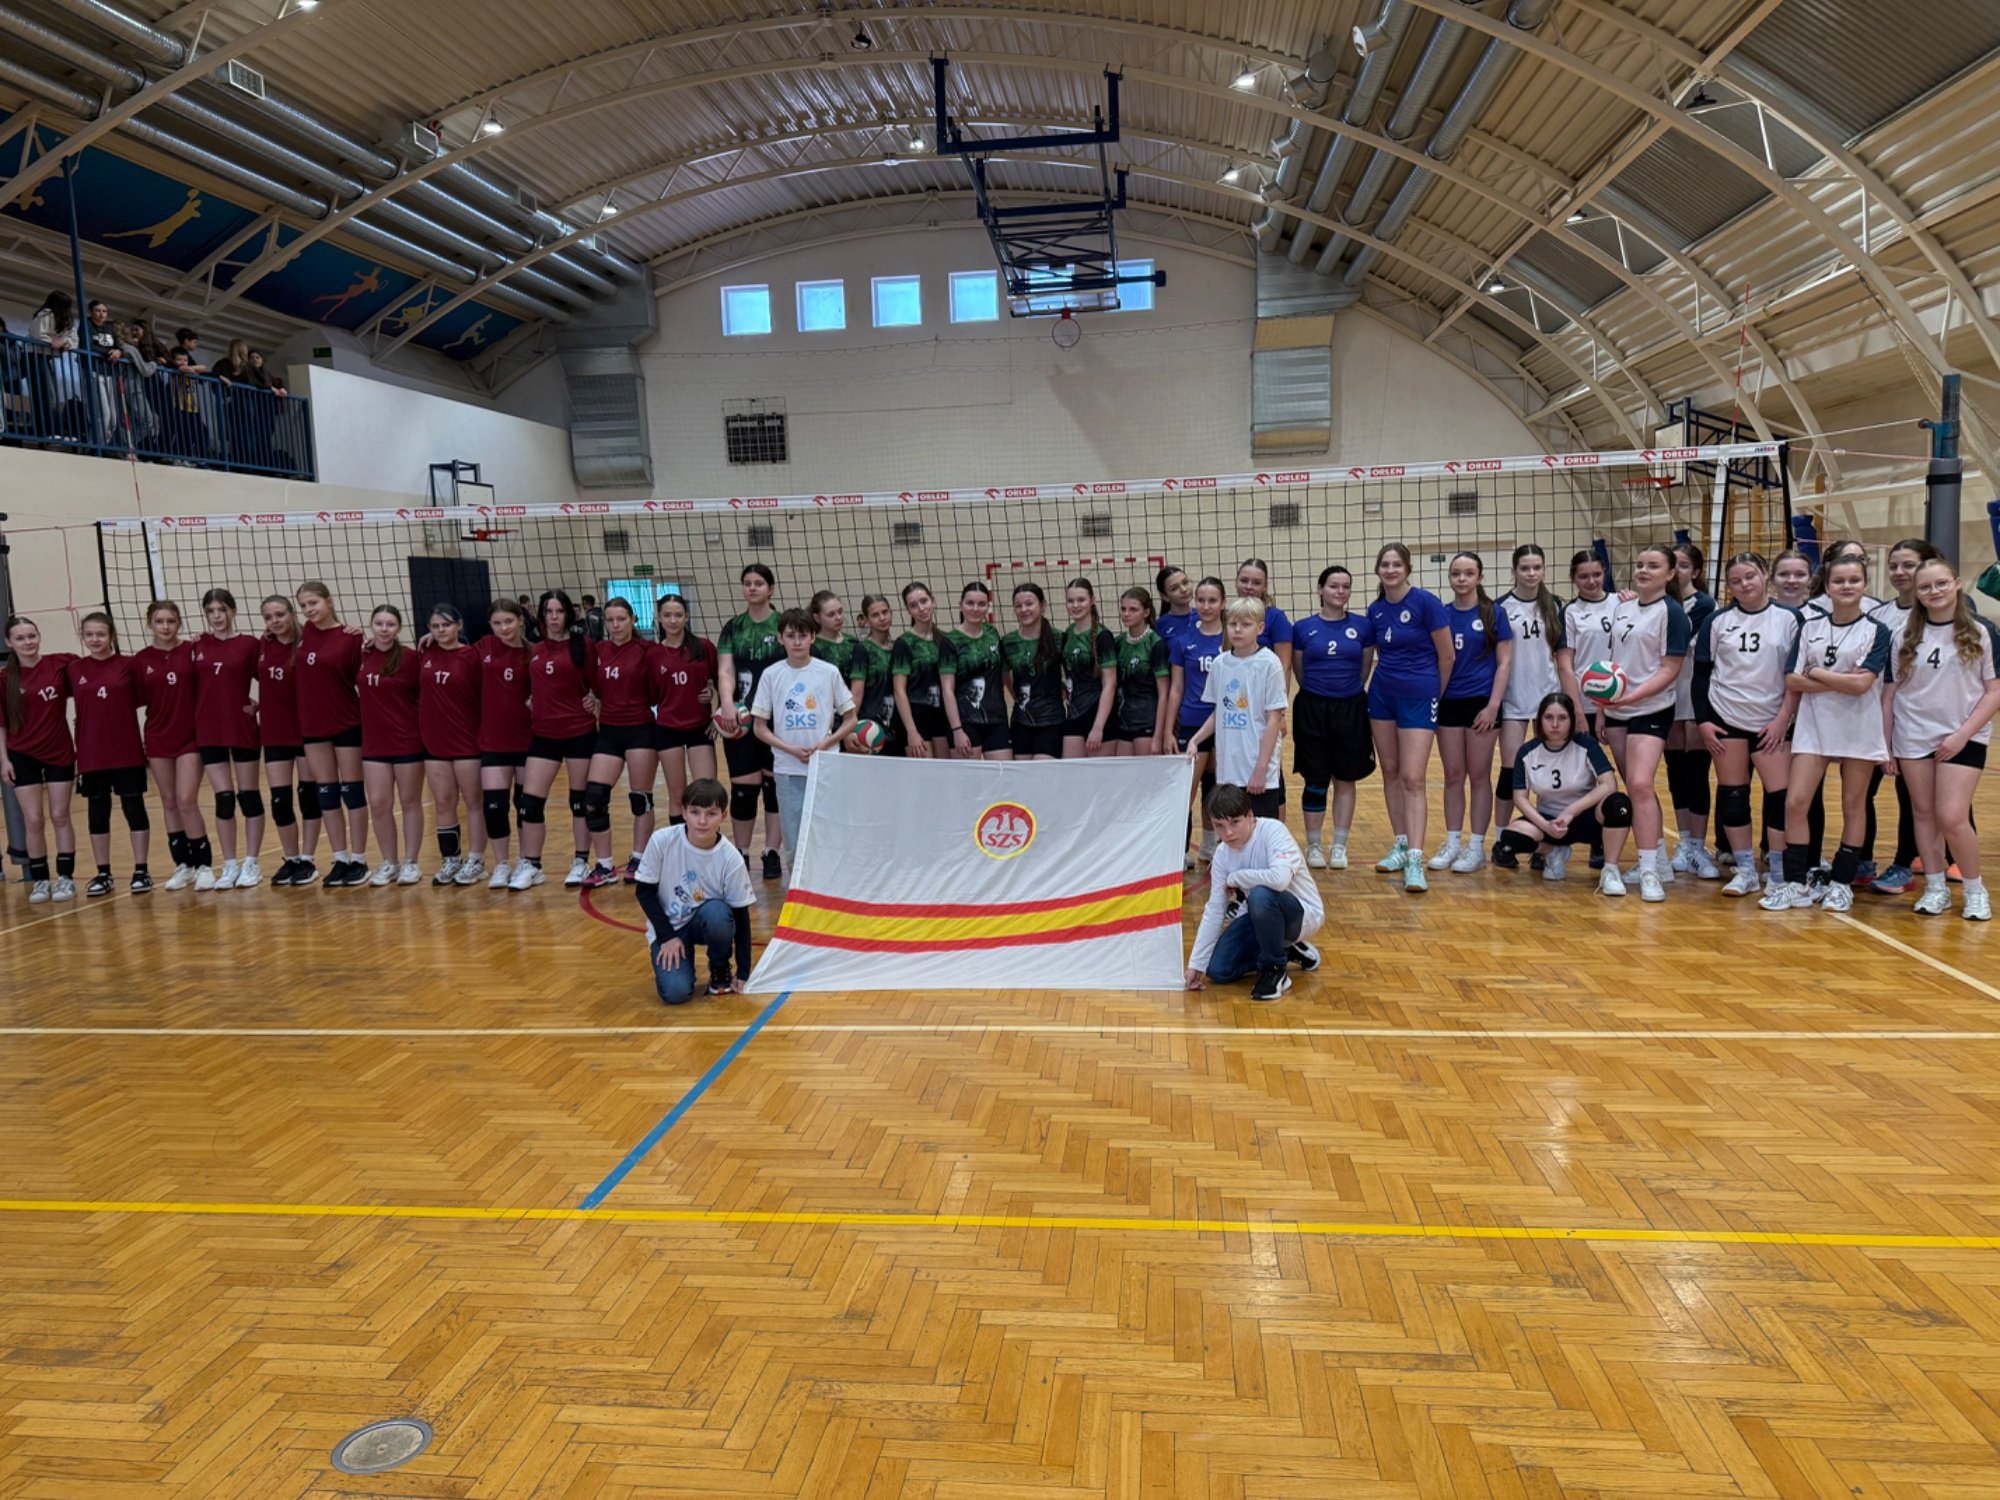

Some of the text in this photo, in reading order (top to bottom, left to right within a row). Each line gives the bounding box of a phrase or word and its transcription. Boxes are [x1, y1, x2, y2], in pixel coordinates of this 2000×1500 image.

[1565, 455, 1598, 465] ORLEN
[1663, 449, 1697, 459] ORLEN
[1371, 467, 1404, 476] ORLEN
[1467, 461, 1500, 471] ORLEN
[1184, 478, 1215, 488] ORLEN
[1277, 473, 1308, 482] ORLEN
[1006, 489, 1035, 497] ORLEN
[1094, 484, 1124, 493] ORLEN
[664, 502, 692, 510] ORLEN
[749, 499, 777, 508] ORLEN
[834, 496, 862, 504] ORLEN
[580, 504, 608, 512] ORLEN
[257, 515, 284, 523] ORLEN
[1522, 619, 1541, 640] 14
[1600, 616, 1612, 633] 6
[1384, 627, 1392, 643] 4
[1621, 624, 1634, 643] 7
[1327, 640, 1337, 655] 2
[1454, 633, 1464, 650] 5
[1738, 631, 1761, 653] 13
[307, 651, 317, 666] 8
[1198, 655, 1213, 672] 16
[1824, 646, 1838, 667] 5
[1926, 647, 1941, 669] 4
[213, 662, 223, 676] 7
[268, 666, 285, 681] 13
[503, 667, 514, 682] 6
[545, 660, 555, 675] 5
[604, 666, 620, 680] 14
[166, 671, 177, 685] 9
[366, 673, 381, 687] 11
[435, 670, 450, 685] 17
[671, 671, 689, 686] 10
[37, 685, 59, 702] 12
[97, 686, 108, 699] 4
[785, 713, 818, 728] SKS
[1551, 768, 1562, 790] 3
[985, 833, 1023, 848] SZS
